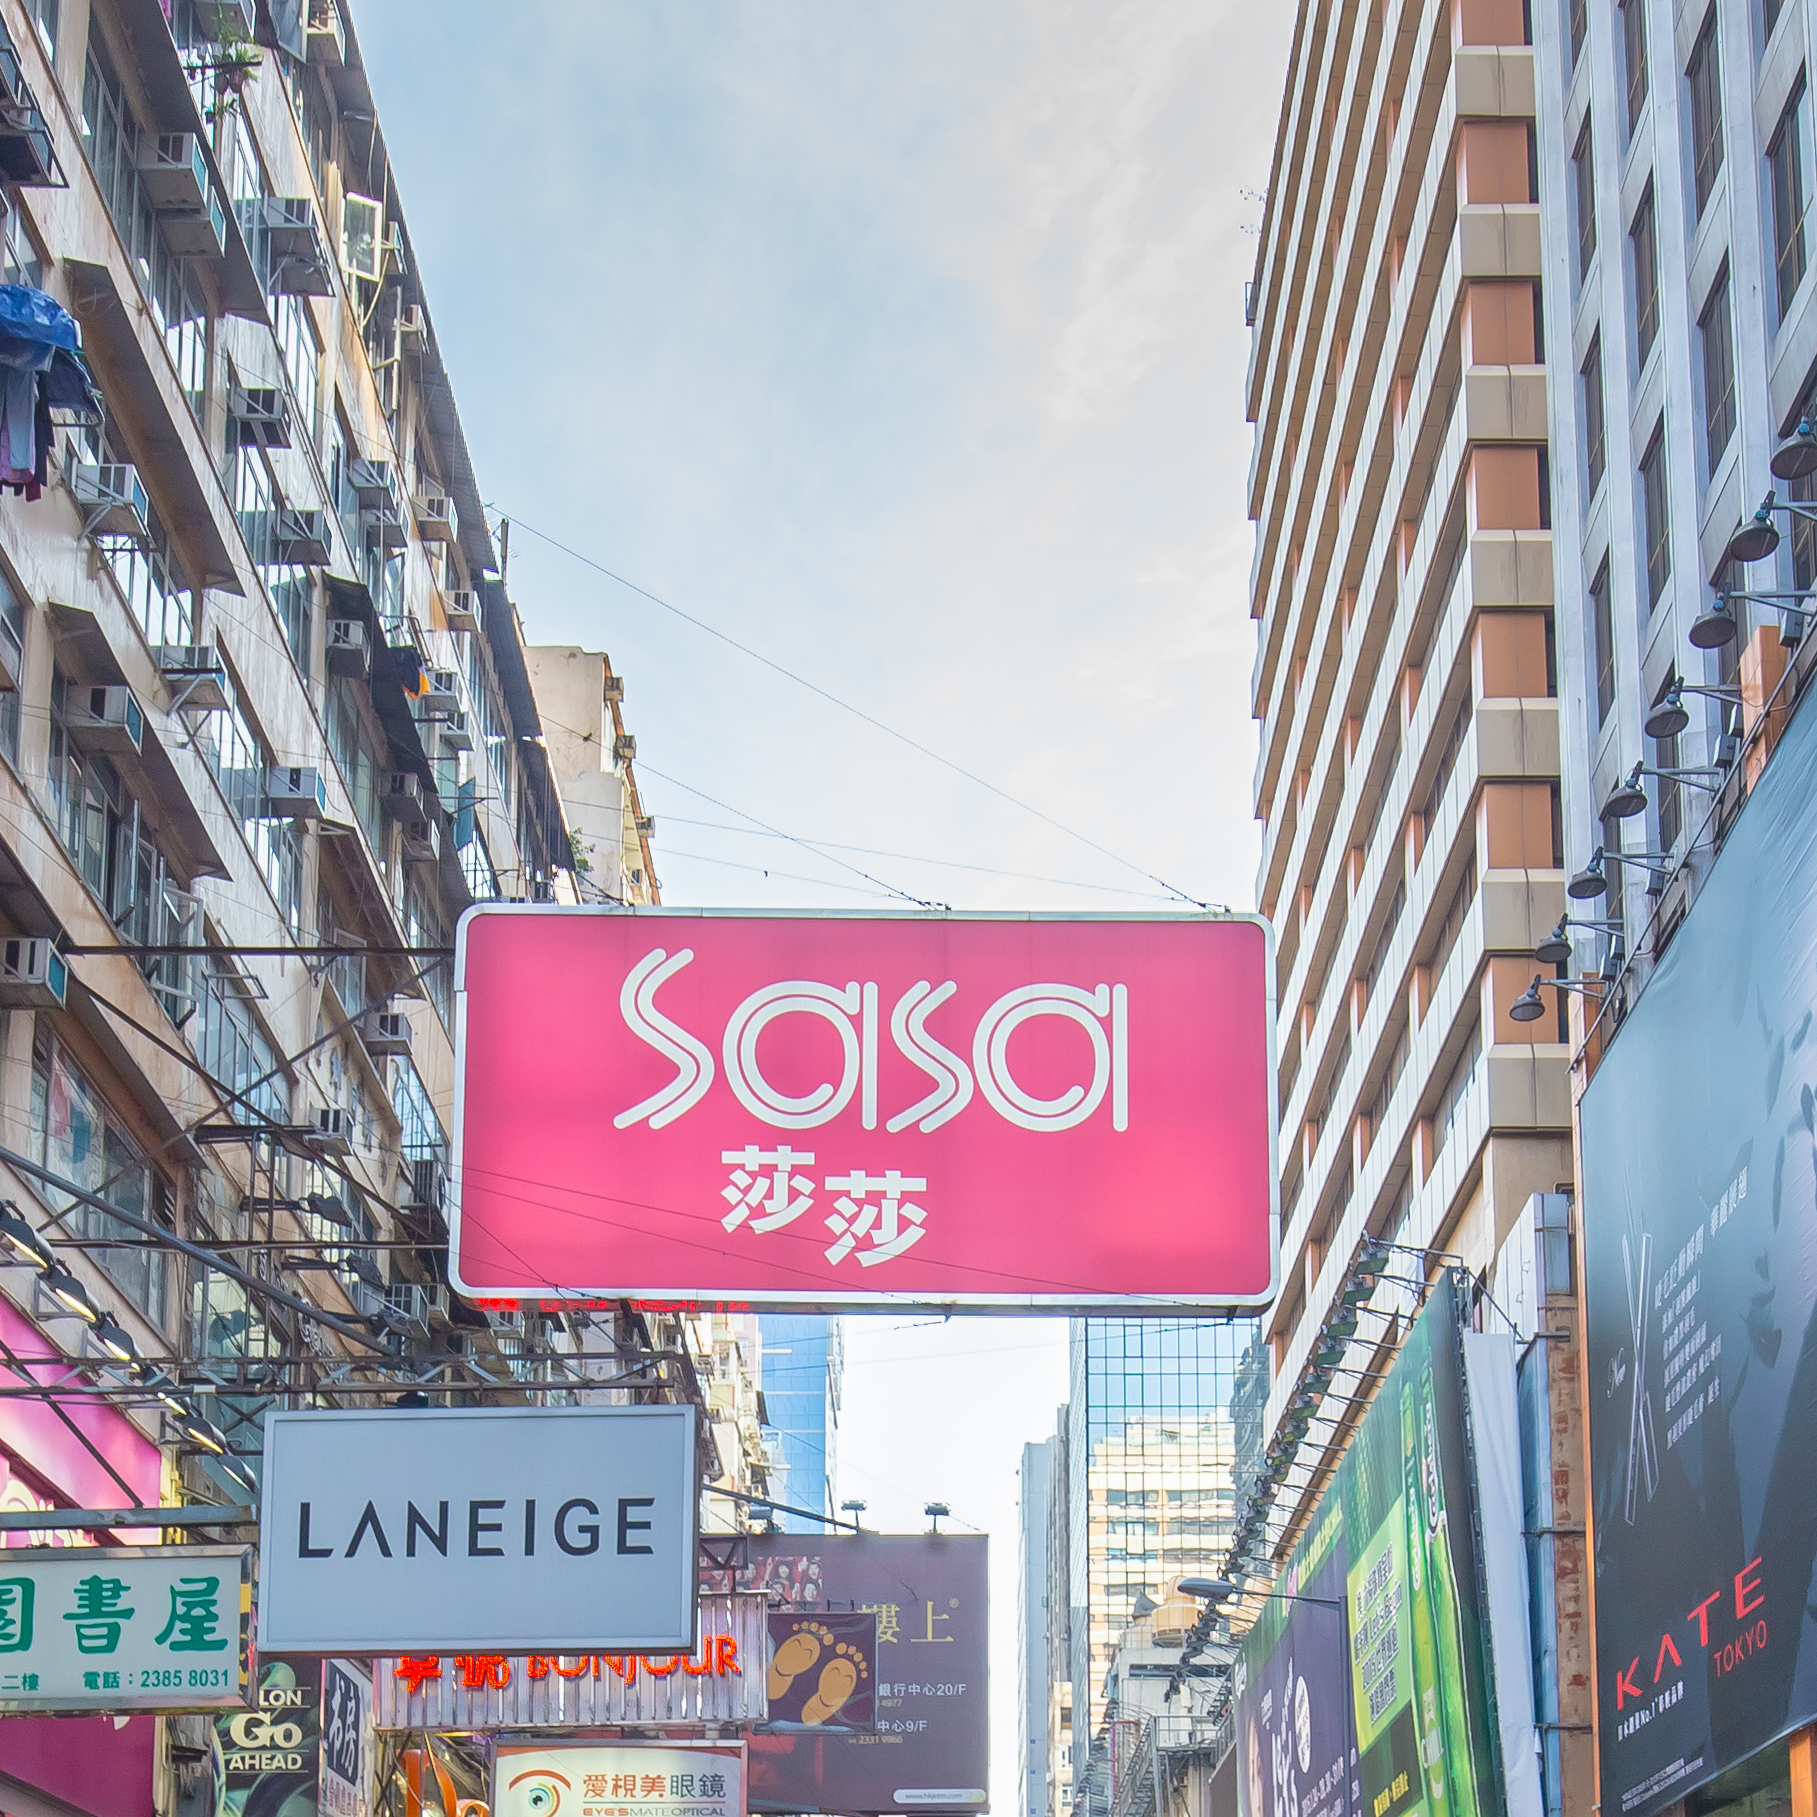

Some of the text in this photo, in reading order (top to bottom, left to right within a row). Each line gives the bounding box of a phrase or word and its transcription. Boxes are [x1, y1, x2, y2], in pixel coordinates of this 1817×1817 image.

[720, 1144, 928, 1268] 莎莎
[298, 1497, 655, 1559] LANEIGE
[1616, 1556, 1765, 1712] KATE
[1713, 1620, 1768, 1677] TOKYO
[140, 1668, 229, 1689] 2385 8031
[229, 1753, 303, 1770] AHEAD
